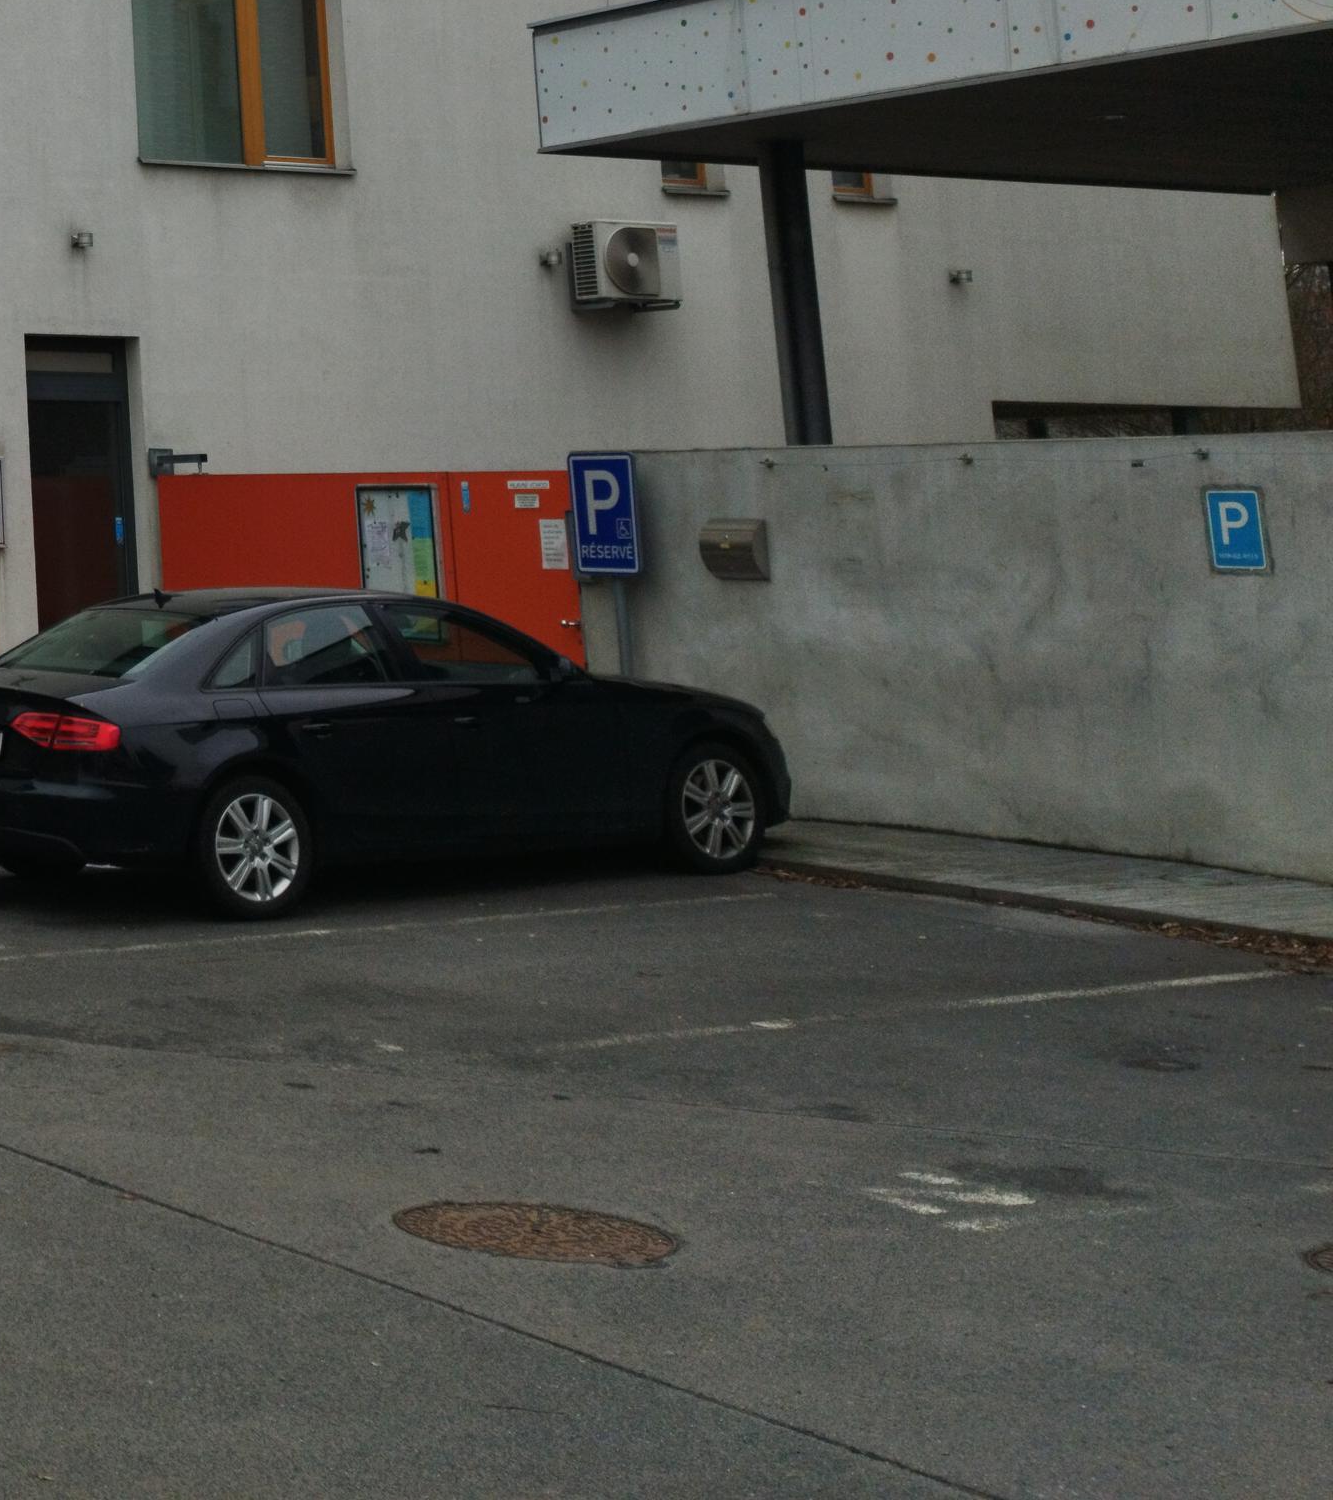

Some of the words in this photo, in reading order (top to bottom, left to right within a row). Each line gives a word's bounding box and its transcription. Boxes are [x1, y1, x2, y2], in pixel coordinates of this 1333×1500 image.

[583, 469, 621, 536] P
[1218, 501, 1250, 546] P
[581, 542, 634, 560] RÉSERVÉ
